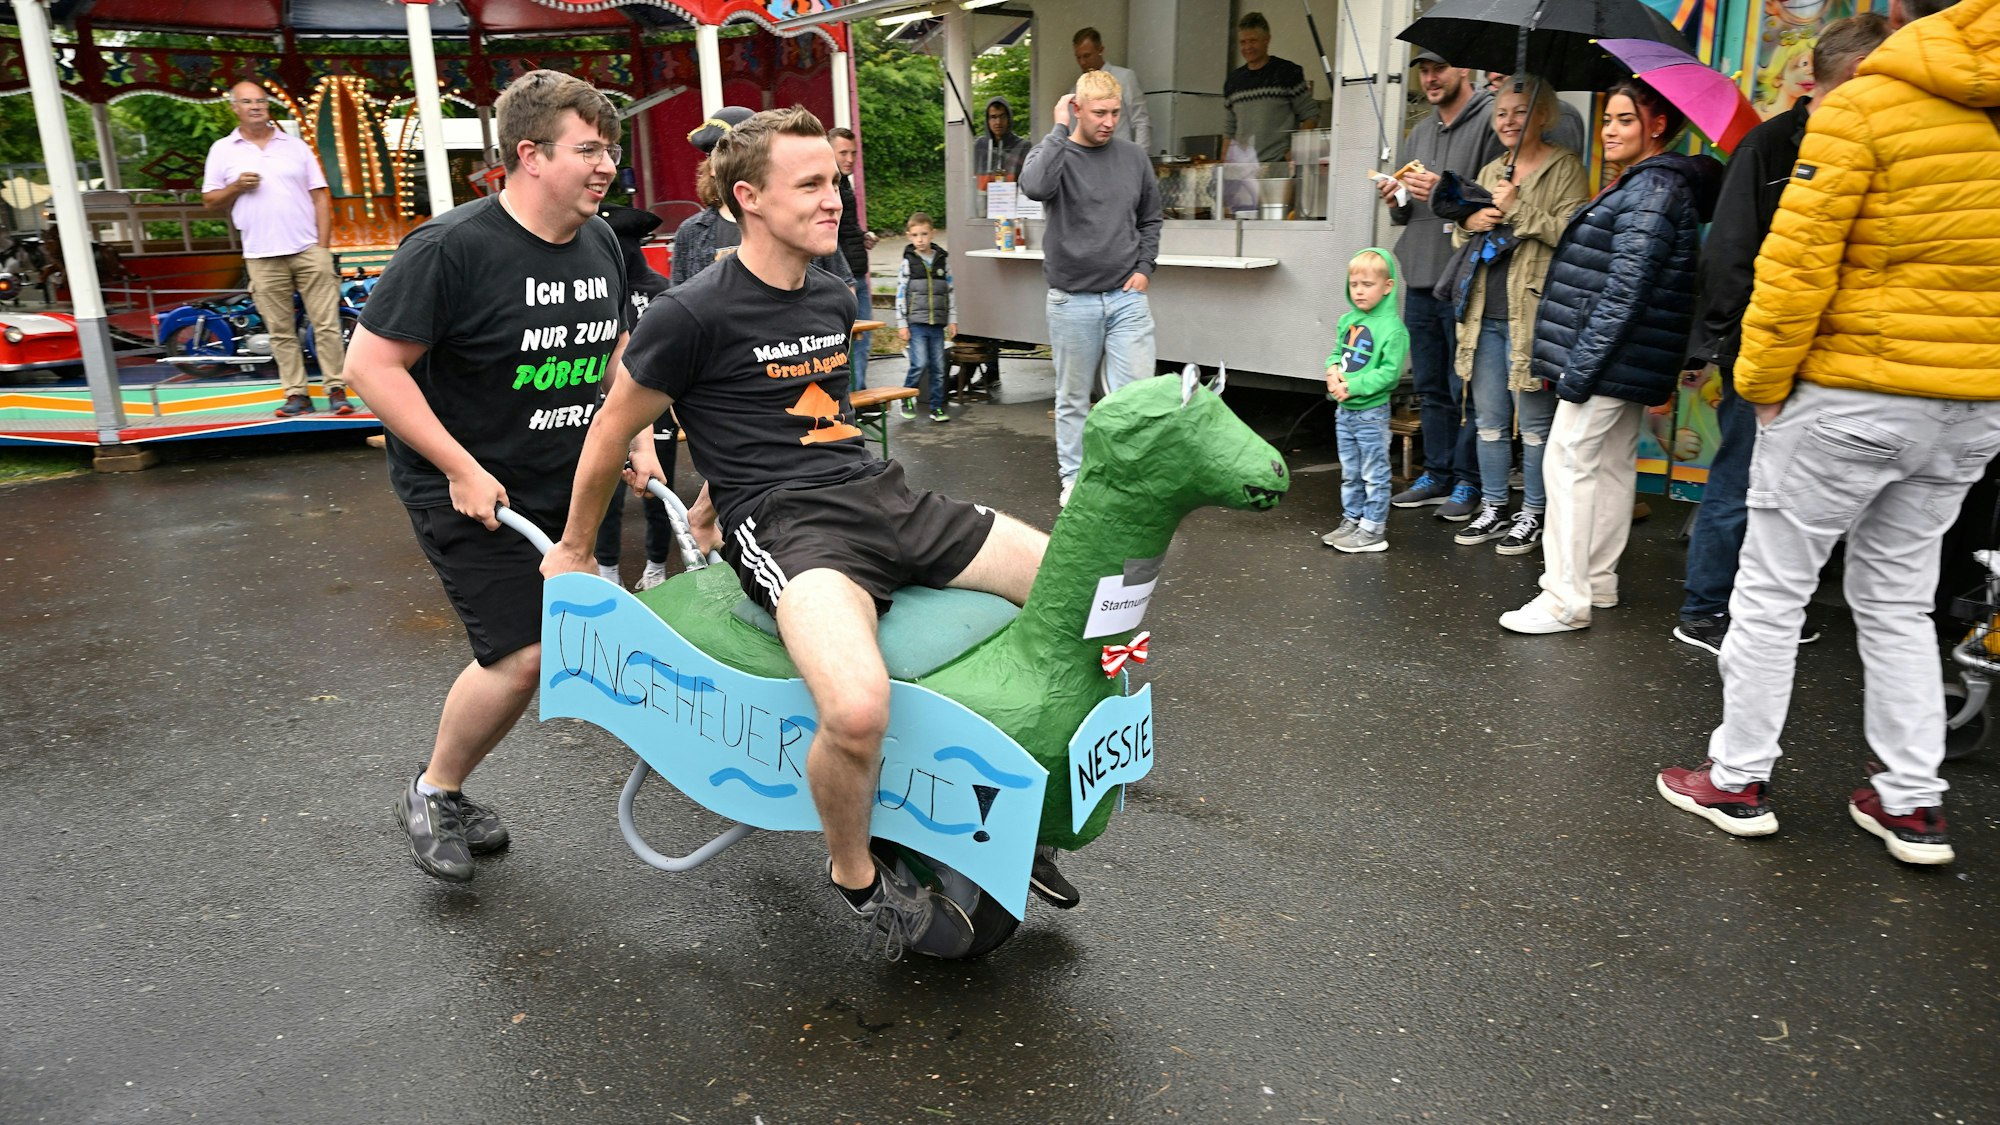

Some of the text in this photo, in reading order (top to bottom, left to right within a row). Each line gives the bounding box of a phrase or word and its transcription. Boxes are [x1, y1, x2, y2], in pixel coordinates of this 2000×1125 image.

[573, 276, 608, 302] BIN
[520, 318, 618, 351] NUR ZUM
[752, 341, 799, 363] Make
[766, 351, 848, 378] Great Again
[528, 403, 595, 430] HIER!
[559, 609, 1001, 843] UNGEHEUER UT!
[1078, 714, 1151, 802] NESSIE
